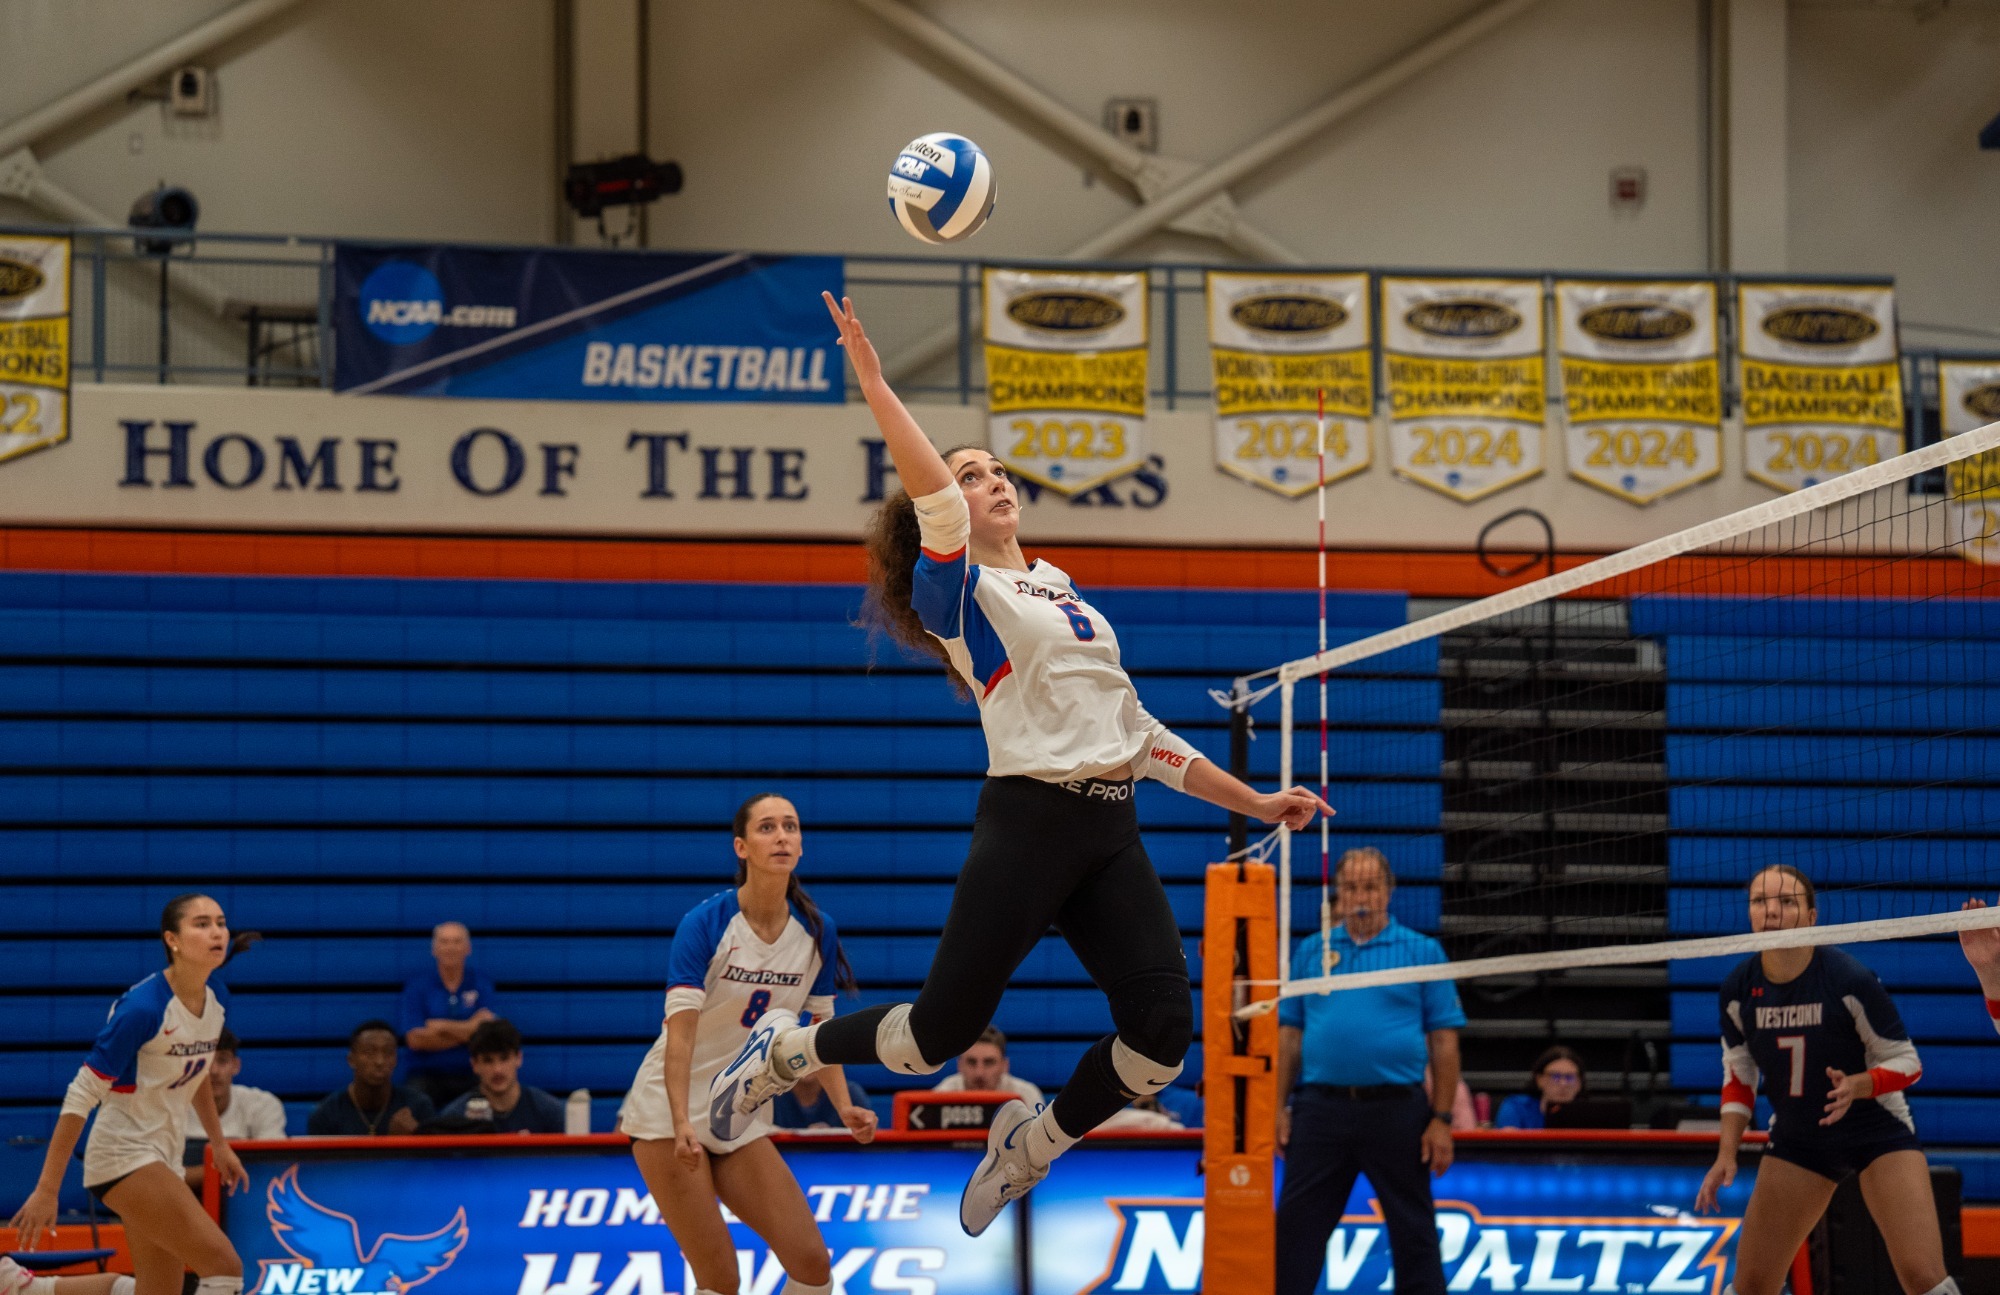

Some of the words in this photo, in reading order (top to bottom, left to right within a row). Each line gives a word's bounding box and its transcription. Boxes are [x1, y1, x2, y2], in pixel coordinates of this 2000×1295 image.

[367, 299, 517, 327] NCAA.com
[582, 342, 831, 392] BASKETBALL
[1745, 367, 1892, 395] BASEBALL
[989, 382, 1146, 404] CHAMPIONS
[1217, 384, 1368, 408] CHAMPIONS
[1390, 389, 1540, 412] CHAMPIONS
[1567, 394, 1715, 417] CHAMPIONS
[1745, 395, 1898, 420] CHAMPIONS
[1010, 420, 1127, 458] 2023
[1235, 420, 1350, 459] 2024
[1409, 427, 1523, 466] 2024
[1585, 427, 1698, 468] 2024
[1766, 431, 1881, 472] 2024
[118, 420, 401, 493] HOME
[449, 426, 580, 499] OF
[626, 430, 810, 501] THE
[1056, 602, 1096, 642] 6
[1087, 782, 1128, 801] PRO
[740, 988, 772, 1028] 8
[1776, 1034, 1806, 1097] 7
[519, 1187, 665, 1228] HOM
[807, 1184, 931, 1223] THE
[259, 1263, 365, 1295] NEW
